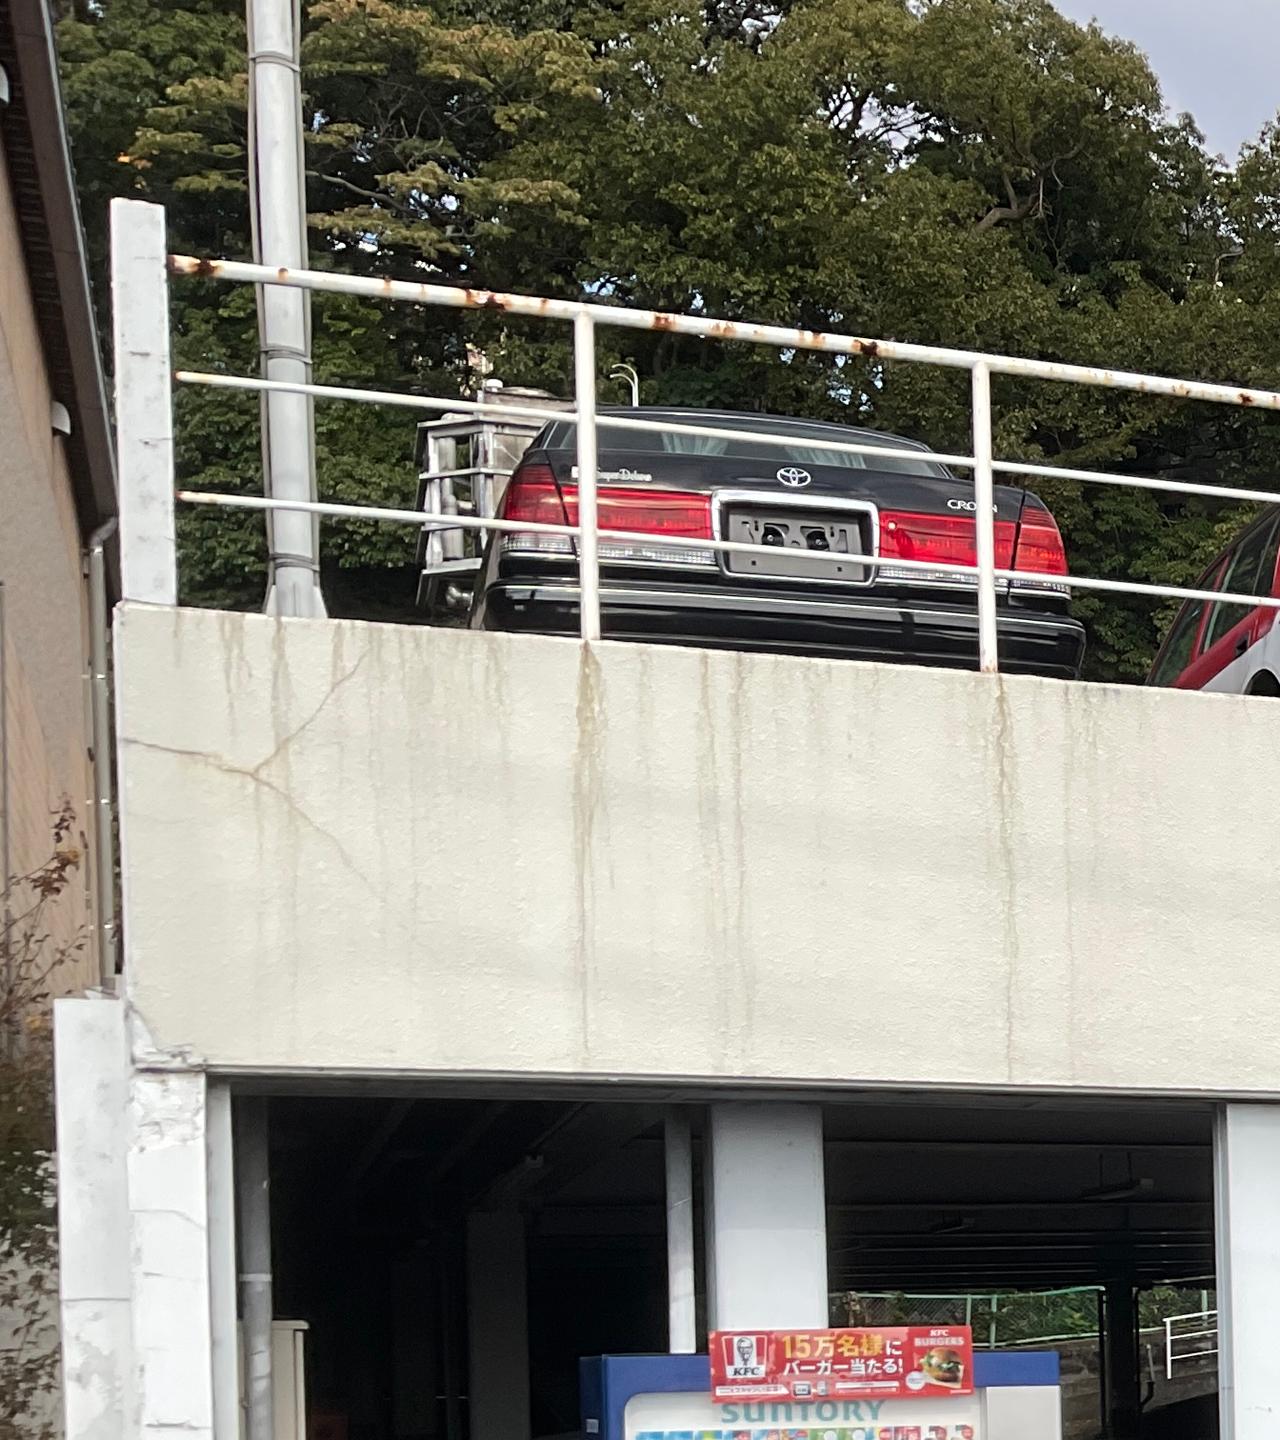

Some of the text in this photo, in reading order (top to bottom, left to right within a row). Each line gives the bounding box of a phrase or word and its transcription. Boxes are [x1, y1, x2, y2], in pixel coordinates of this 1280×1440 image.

[782, 1333, 903, 1360] 15万名様に
[913, 1335, 965, 1347] BURGERS
[732, 1366, 761, 1377] KFC
